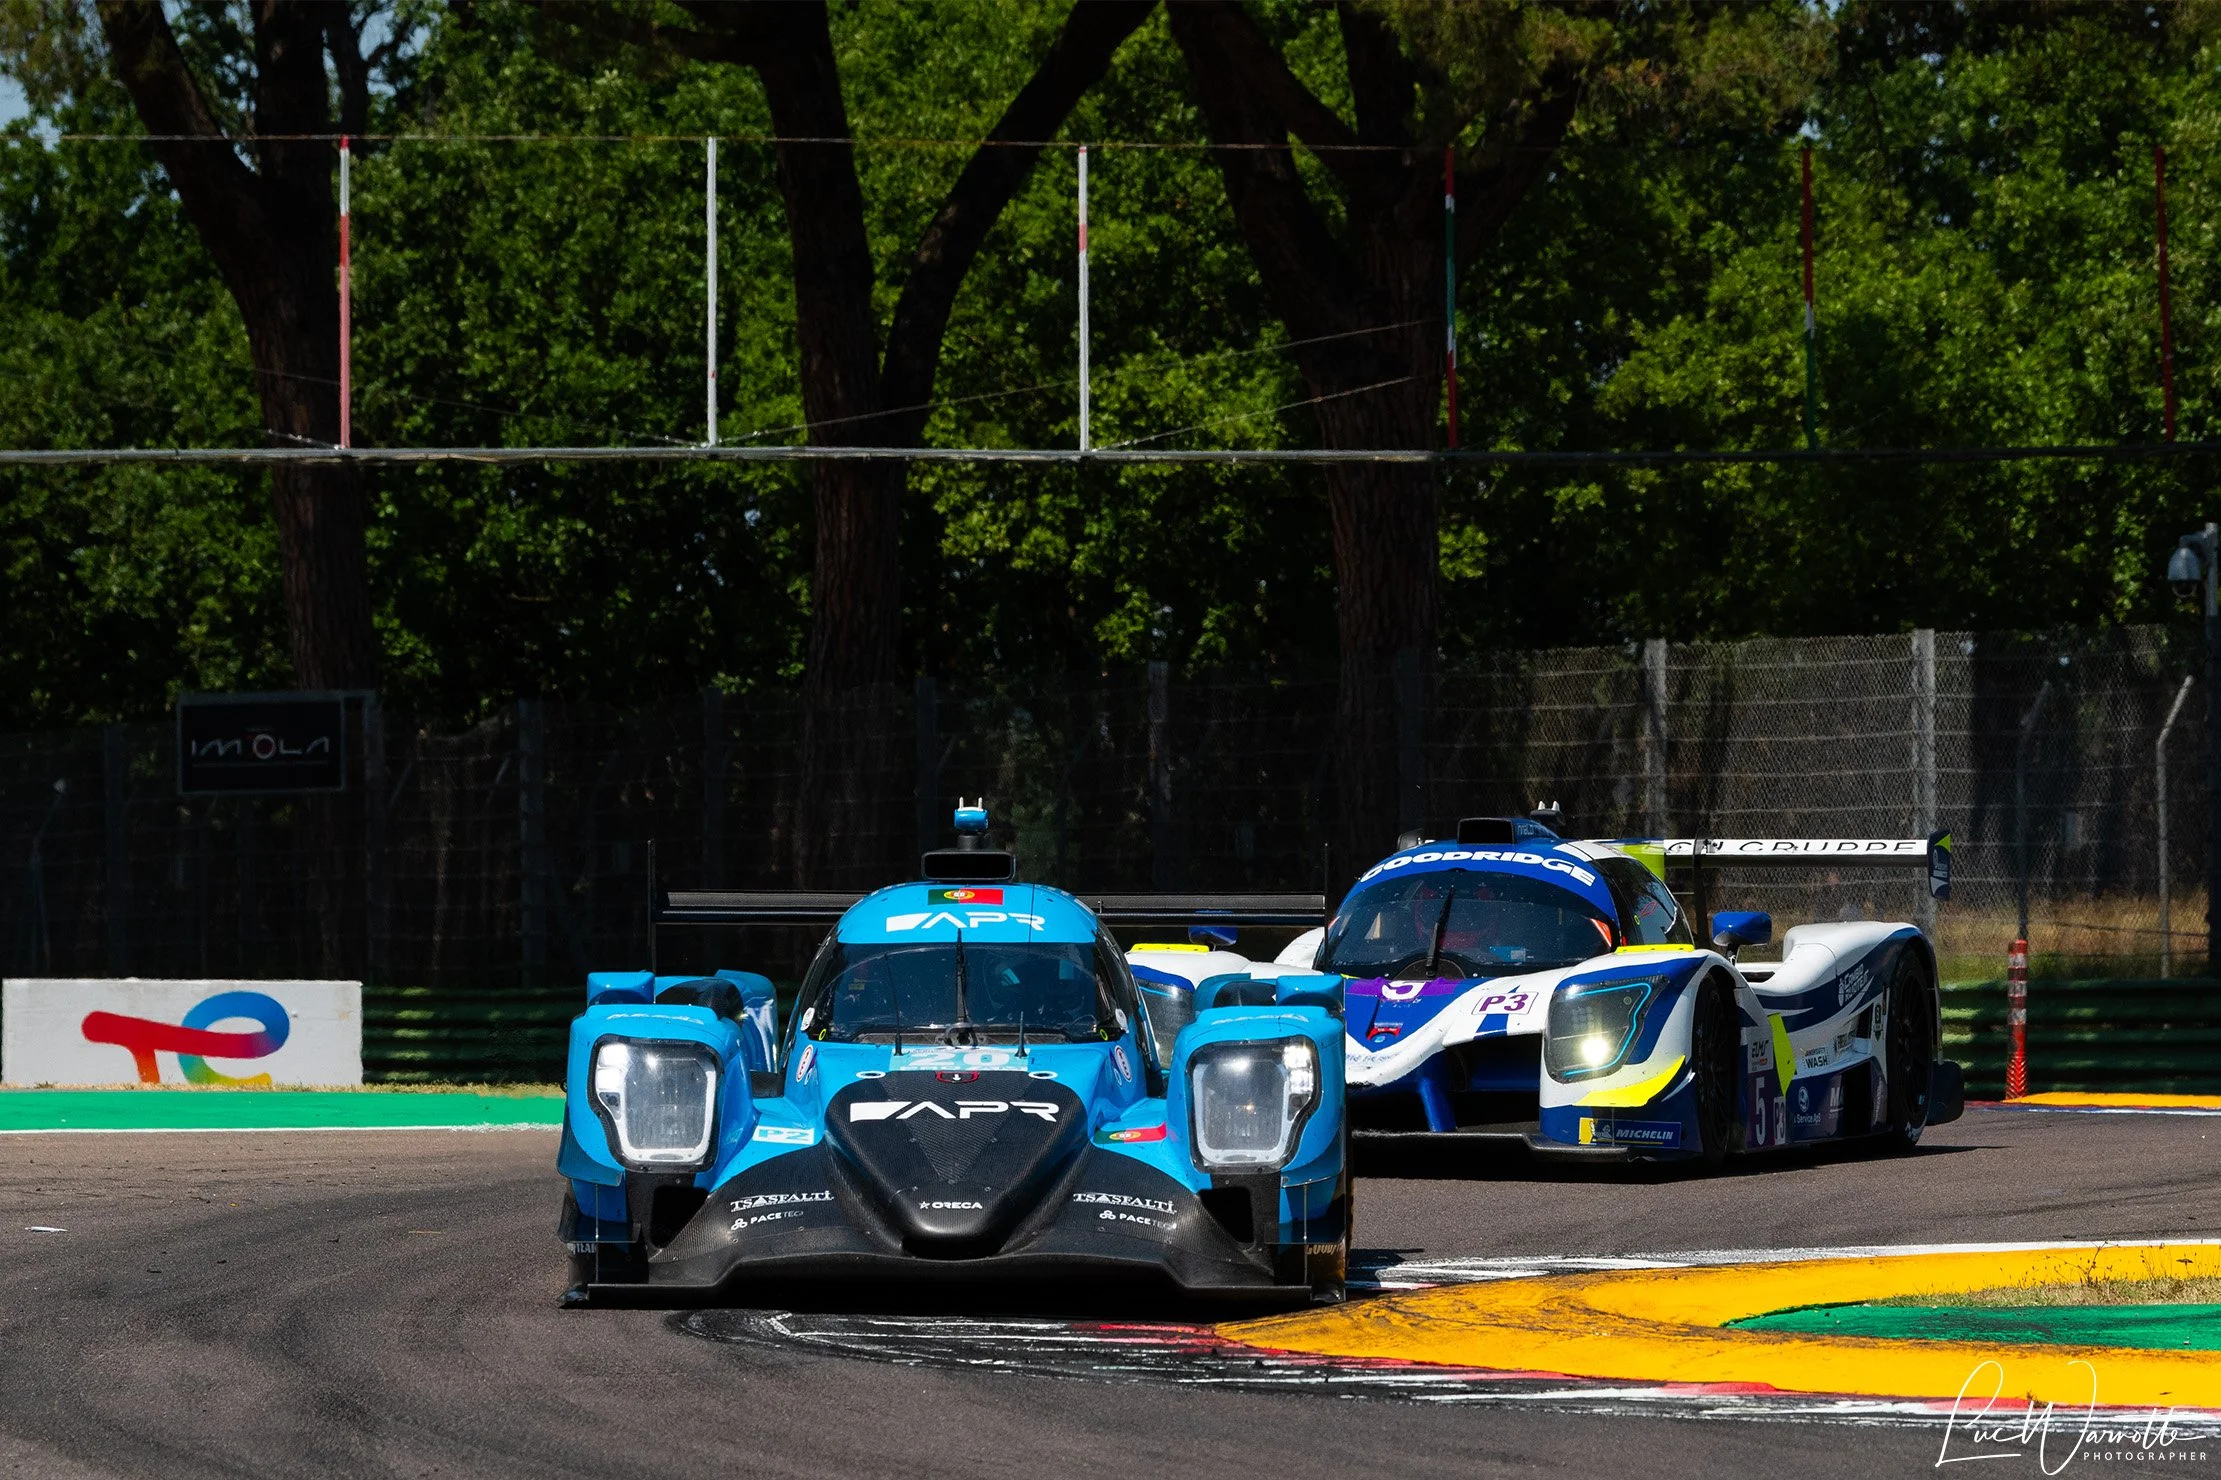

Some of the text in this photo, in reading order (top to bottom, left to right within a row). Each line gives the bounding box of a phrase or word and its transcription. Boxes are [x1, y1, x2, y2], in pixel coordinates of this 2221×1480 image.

[191, 732, 330, 760] IMOLA
[1360, 851, 1596, 887] GOODRIDGE
[922, 911, 1046, 931] APR
[1479, 993, 1530, 1013] P3
[908, 1051, 1010, 1067] 20
[1805, 1054, 1828, 1068] WASH
[896, 1100, 1060, 1123] APR
[1755, 1076, 1766, 1146] 5
[758, 1126, 811, 1142] P2
[1616, 1128, 1674, 1140] MICHELIN
[932, 1200, 983, 1210] ORECA
